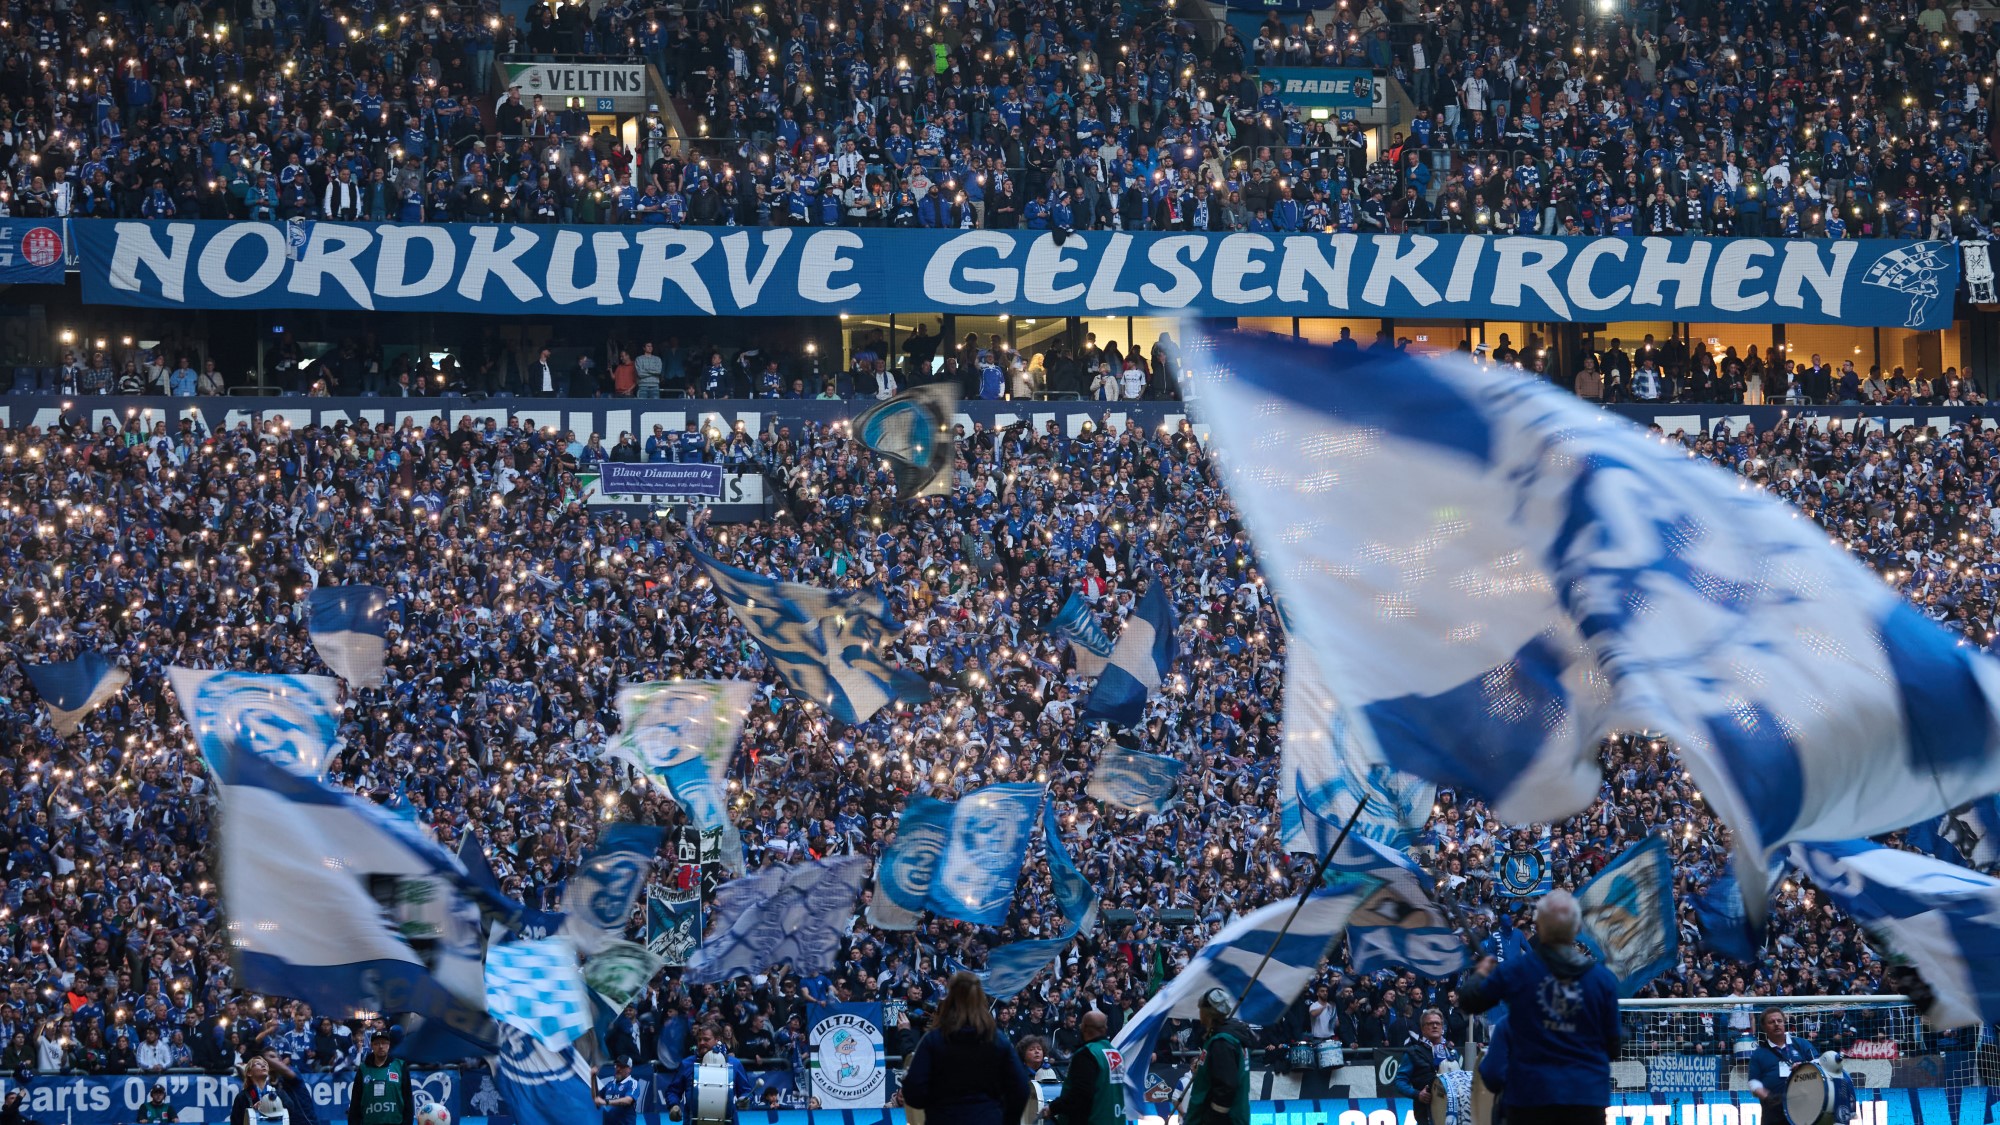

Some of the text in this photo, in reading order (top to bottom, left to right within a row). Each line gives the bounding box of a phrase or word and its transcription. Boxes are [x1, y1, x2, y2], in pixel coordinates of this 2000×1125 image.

[547, 69, 641, 92] VELTINS
[1285, 79, 1351, 94] RADE
[599, 100, 612, 110] 32
[1341, 111, 1353, 120] 34
[109, 221, 864, 316] NORDKURVE
[923, 230, 1859, 321] GELSENKIRCHEN
[612, 467, 712, 479] Blaue Diamanten 04
[815, 1015, 876, 1036] ULTRAS
[1649, 1056, 1716, 1070] FUSSBALLCLUB
[1650, 1071, 1716, 1086] GELSENKIRCHEN
[365, 1102, 397, 1114] HOST
